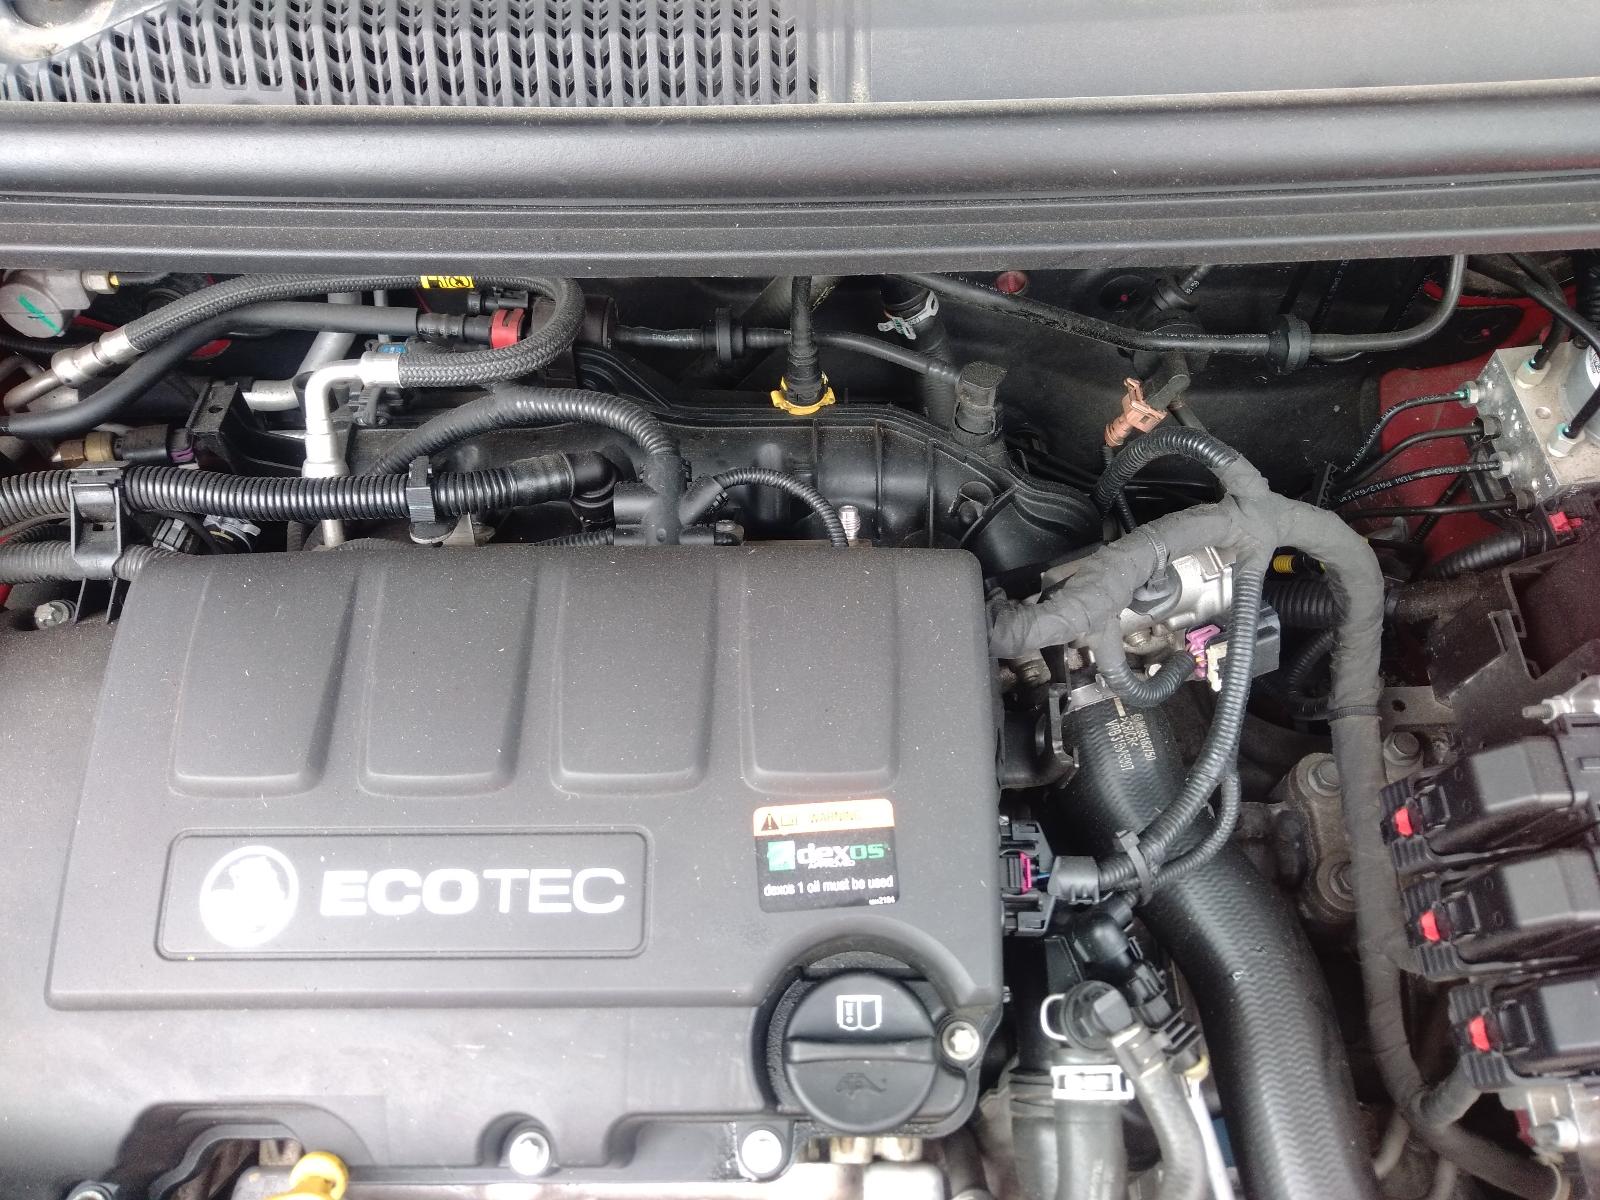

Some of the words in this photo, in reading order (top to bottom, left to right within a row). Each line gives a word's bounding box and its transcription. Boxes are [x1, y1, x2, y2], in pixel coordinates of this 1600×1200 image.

[796, 842, 885, 865] dexos
[319, 868, 626, 916] ECOTEC
[797, 881, 804, 893] 1
[806, 880, 820, 893] oil
[822, 878, 850, 891] must
[851, 877, 866, 889] be
